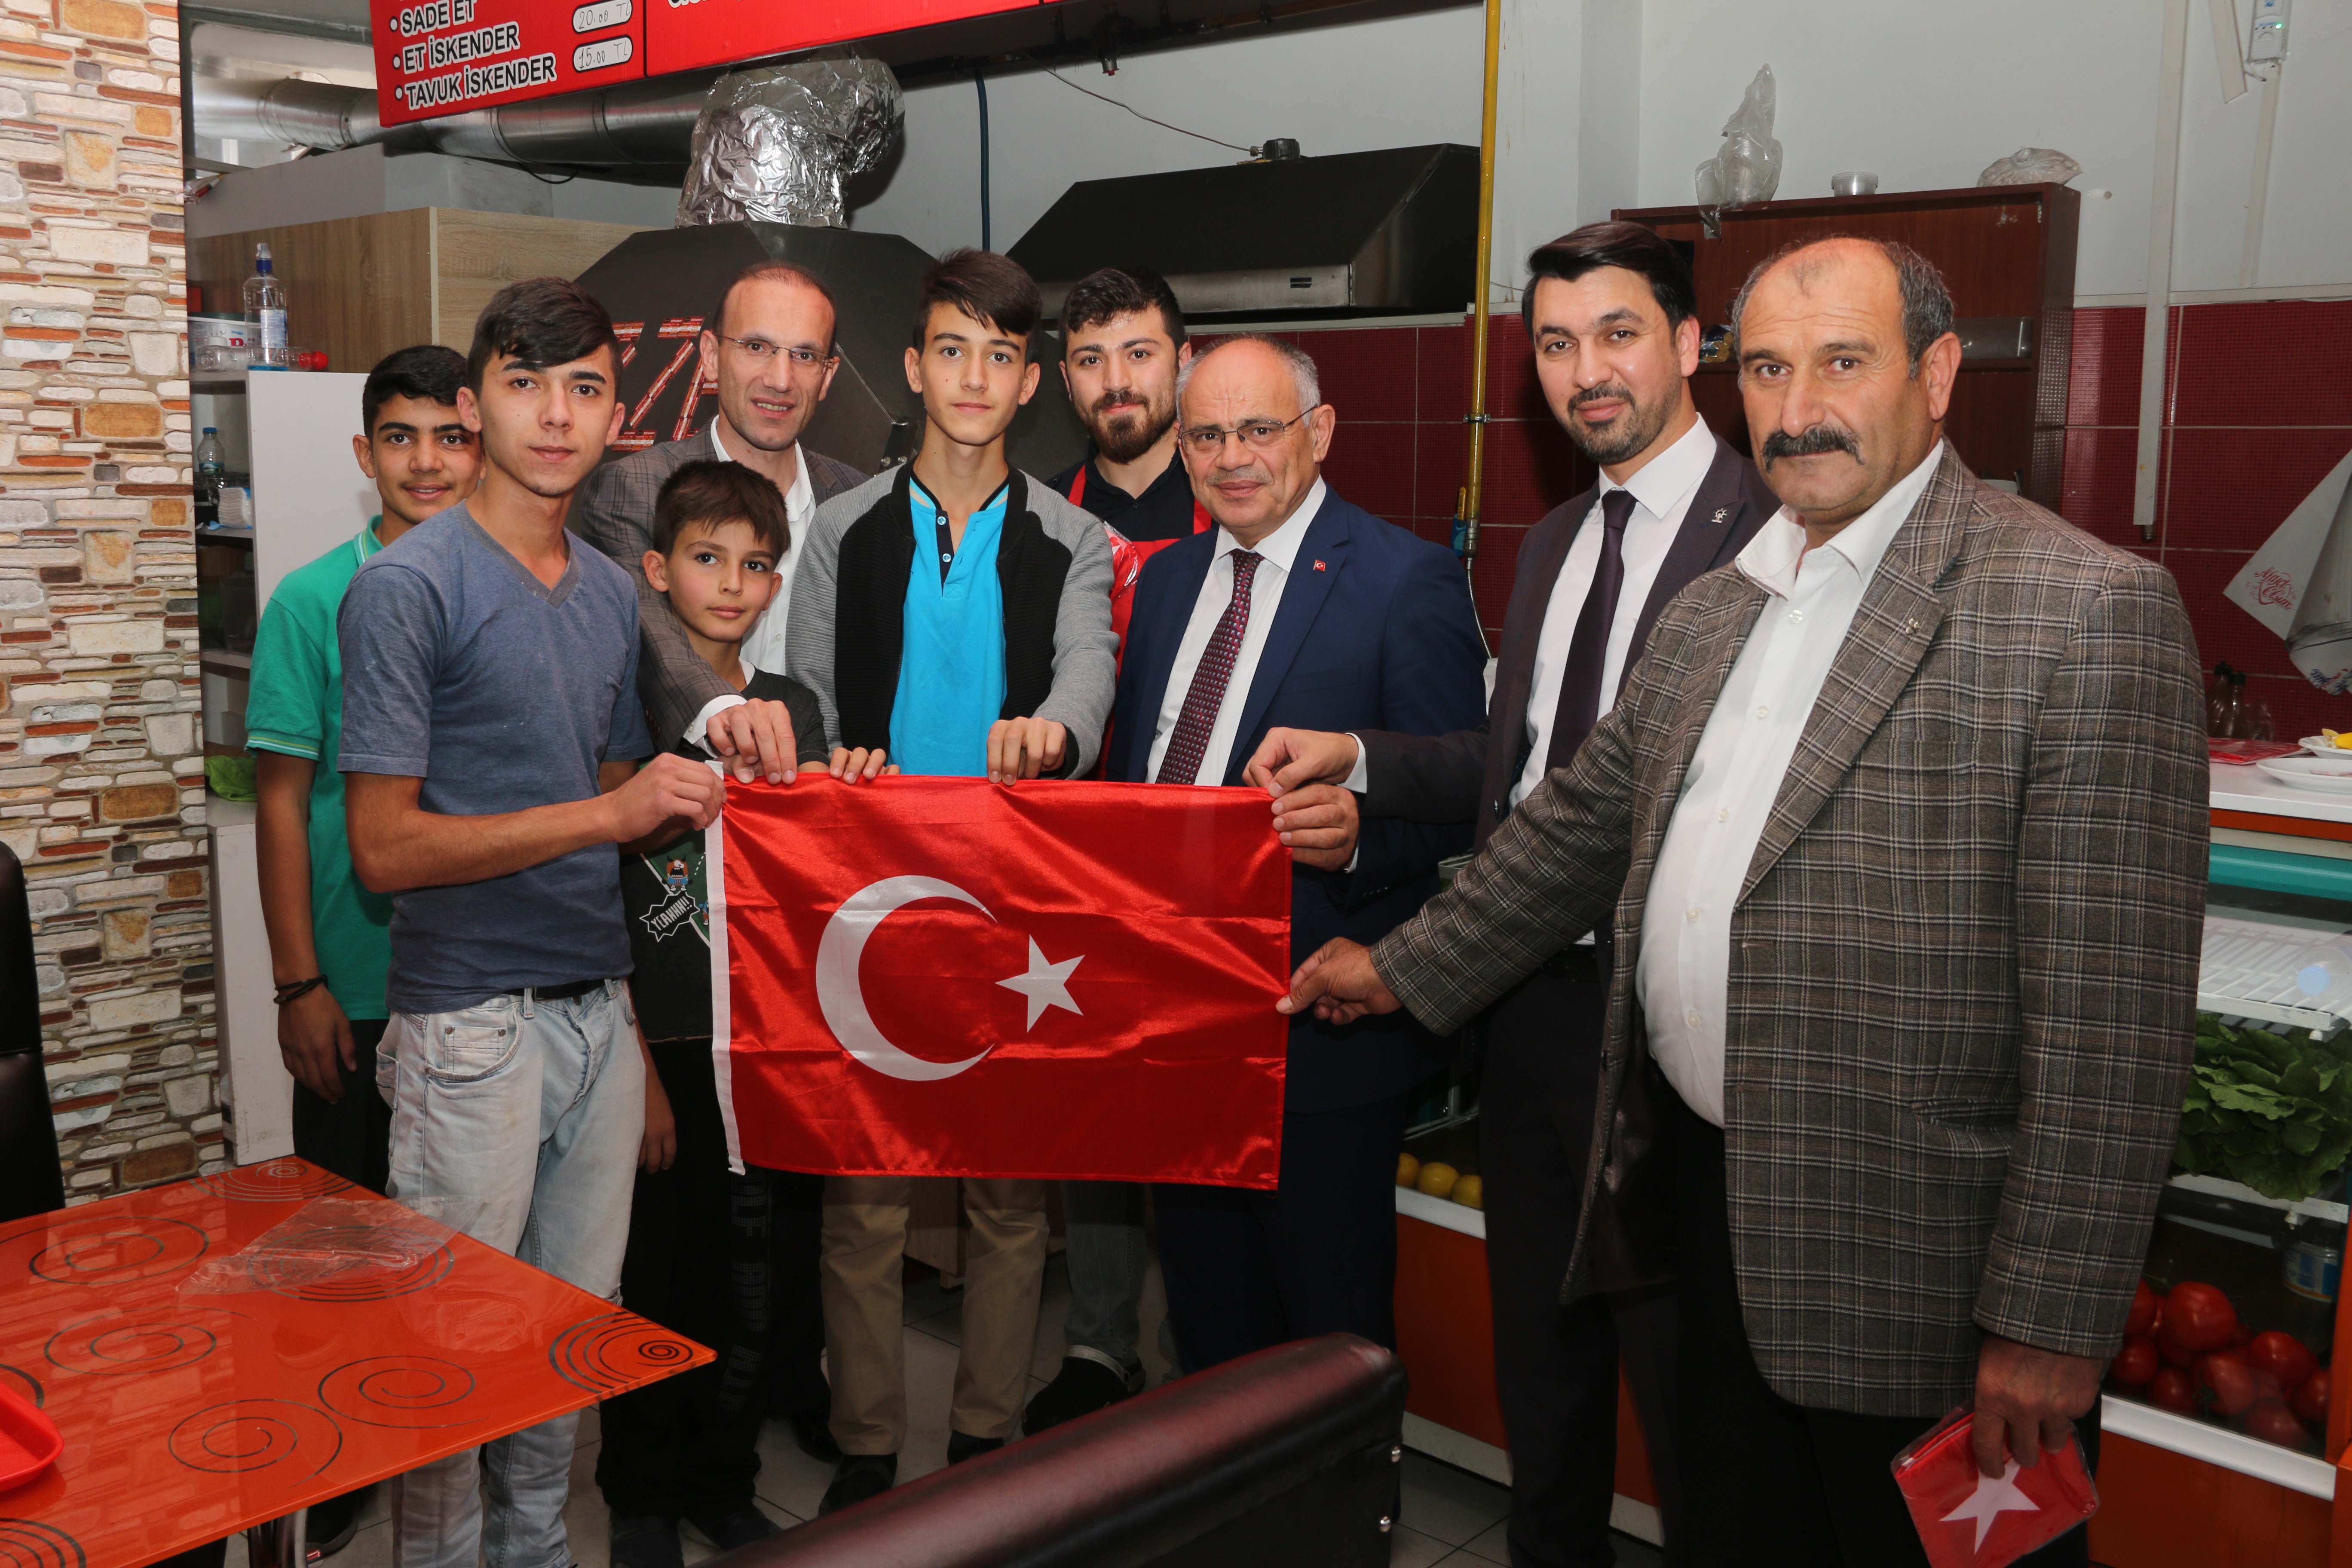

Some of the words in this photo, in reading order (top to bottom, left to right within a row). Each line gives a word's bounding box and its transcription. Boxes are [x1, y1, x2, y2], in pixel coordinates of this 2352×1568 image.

[402, 3, 448, 34] SADE
[454, 0, 475, 22] ET
[404, 46, 425, 70] ET
[430, 24, 518, 65] İSKENDER
[579, 47, 605, 69] 15.00
[406, 75, 461, 107] TAVUK
[466, 55, 555, 95] İSKENDER
